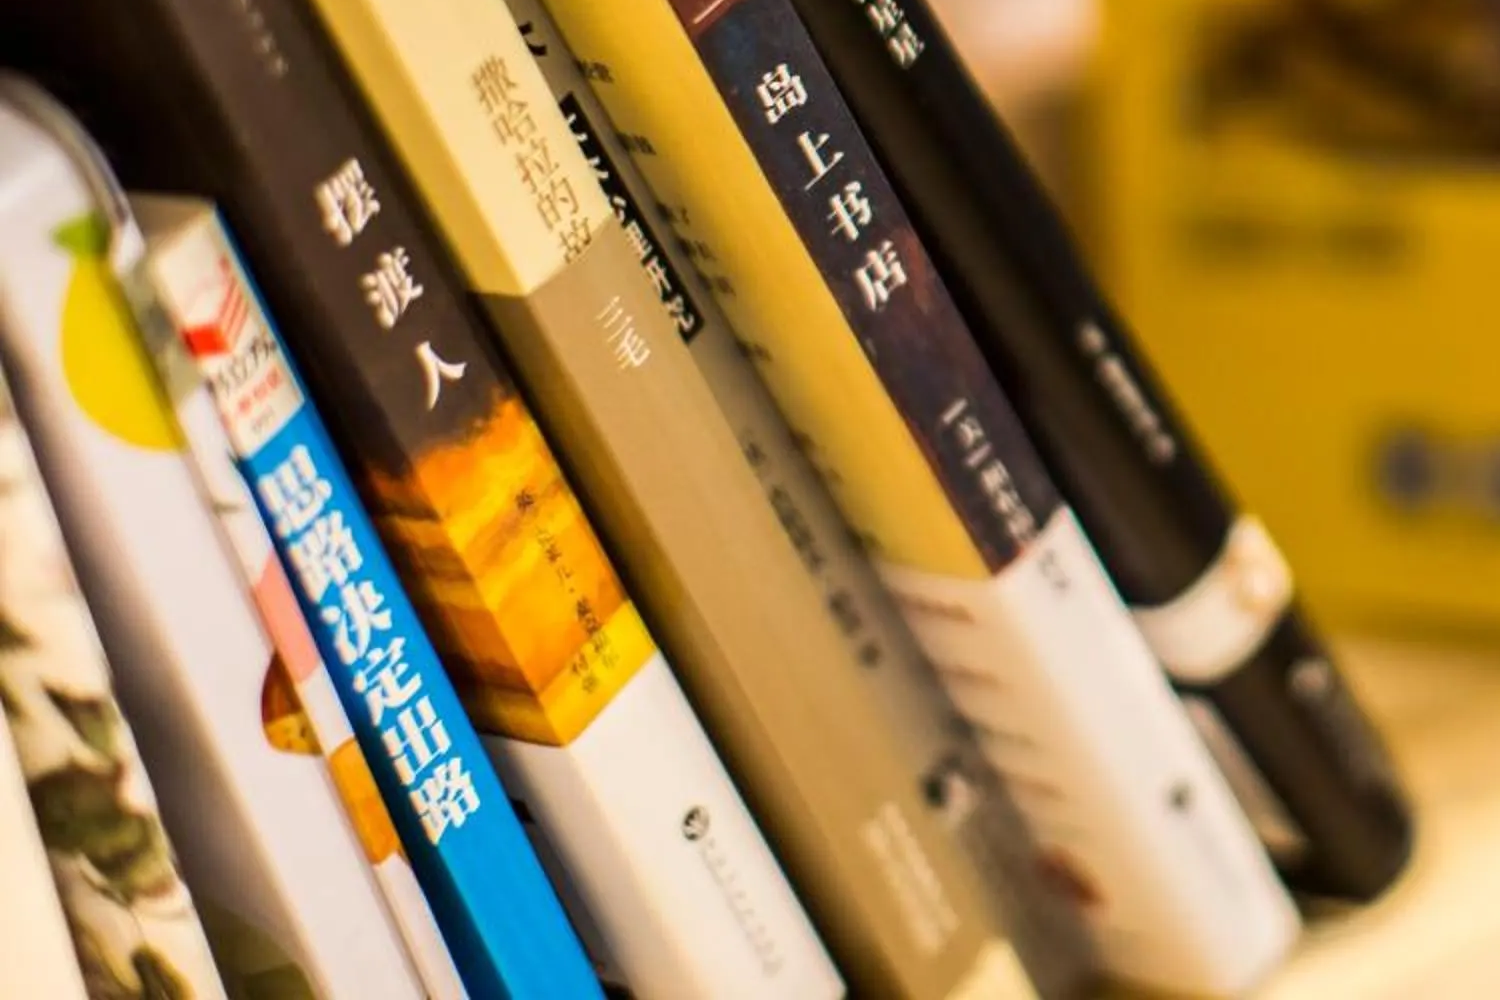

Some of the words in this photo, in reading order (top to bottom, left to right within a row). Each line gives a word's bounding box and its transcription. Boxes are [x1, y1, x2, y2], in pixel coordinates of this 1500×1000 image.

[314, 157, 467, 411] 摆渡人
[470, 54, 593, 264] 撒哈拉的故
[757, 62, 909, 312] 岛上书店
[596, 295, 651, 371] 三毛
[257, 443, 482, 845] 思路决定出路
